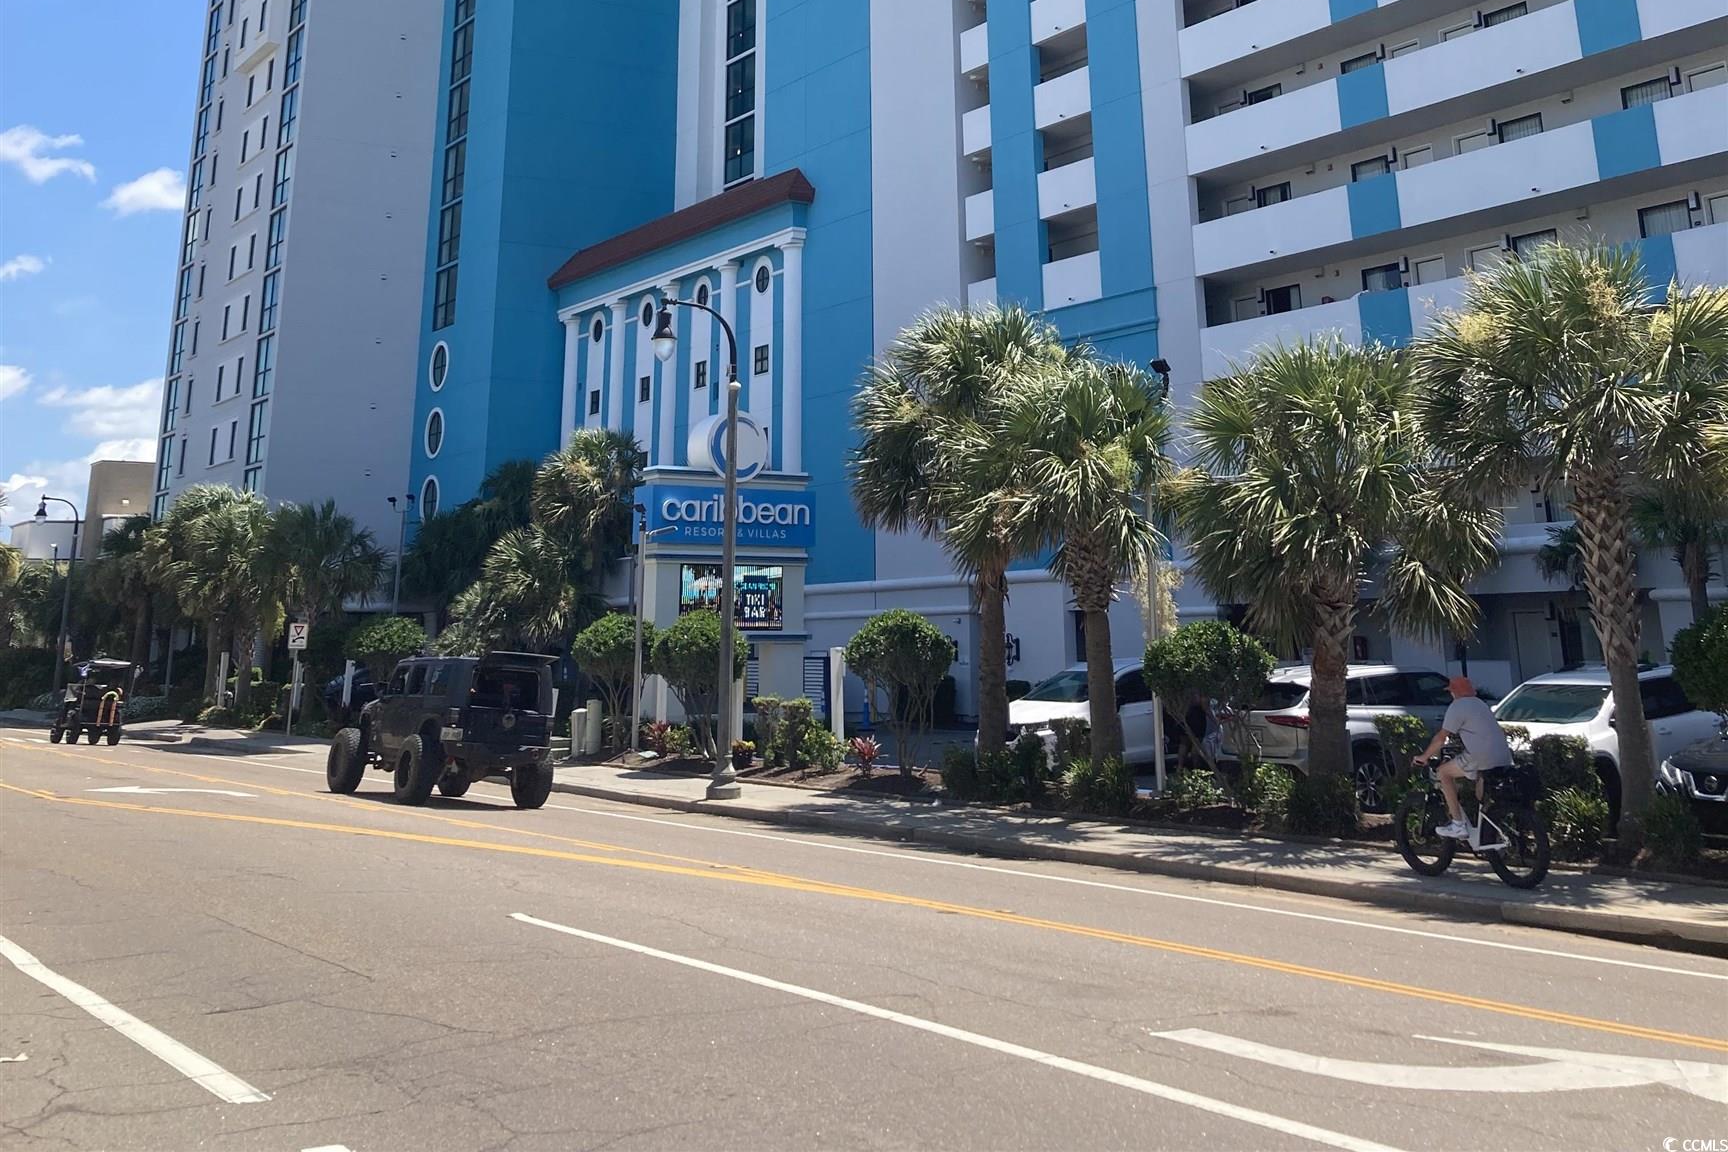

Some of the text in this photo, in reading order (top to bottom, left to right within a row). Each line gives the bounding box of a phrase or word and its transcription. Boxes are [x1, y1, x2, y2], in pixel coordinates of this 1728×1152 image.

[685, 526, 787, 539] RESOR & VILLAS
